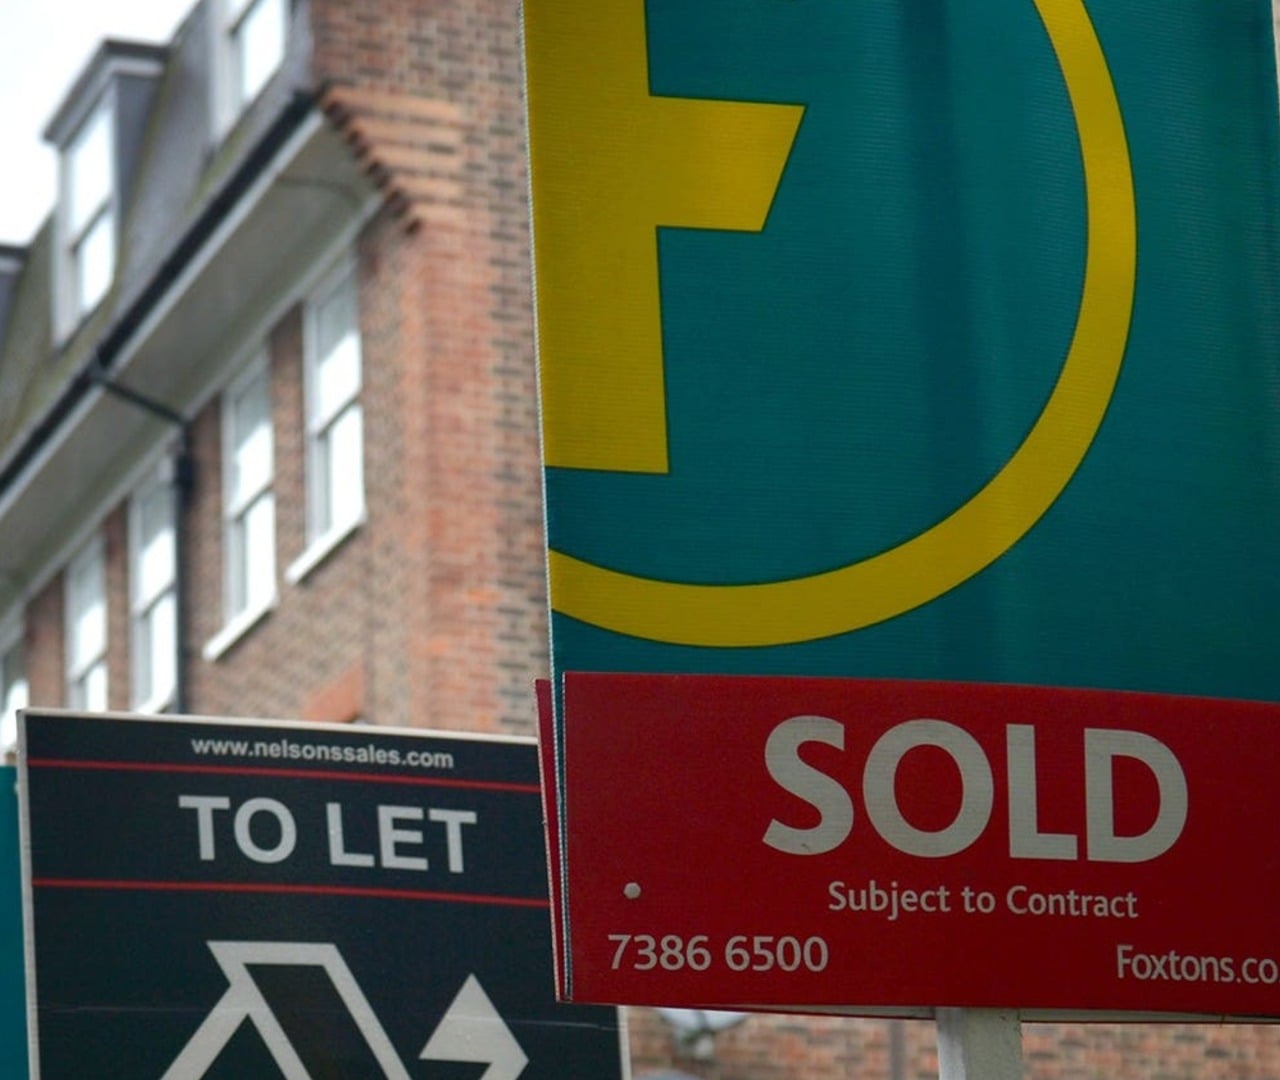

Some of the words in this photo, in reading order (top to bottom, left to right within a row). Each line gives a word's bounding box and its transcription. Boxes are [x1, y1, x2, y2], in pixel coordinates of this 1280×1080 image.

[191, 736, 454, 769] www.nelsonssales.com
[760, 714, 1190, 865] SOLD
[178, 795, 297, 864] TO
[325, 802, 478, 874] LET
[828, 879, 952, 921] Subject
[960, 885, 996, 914] to
[1006, 884, 1139, 919] Contract
[607, 932, 712, 973] 7386
[723, 933, 829, 974] 6500
